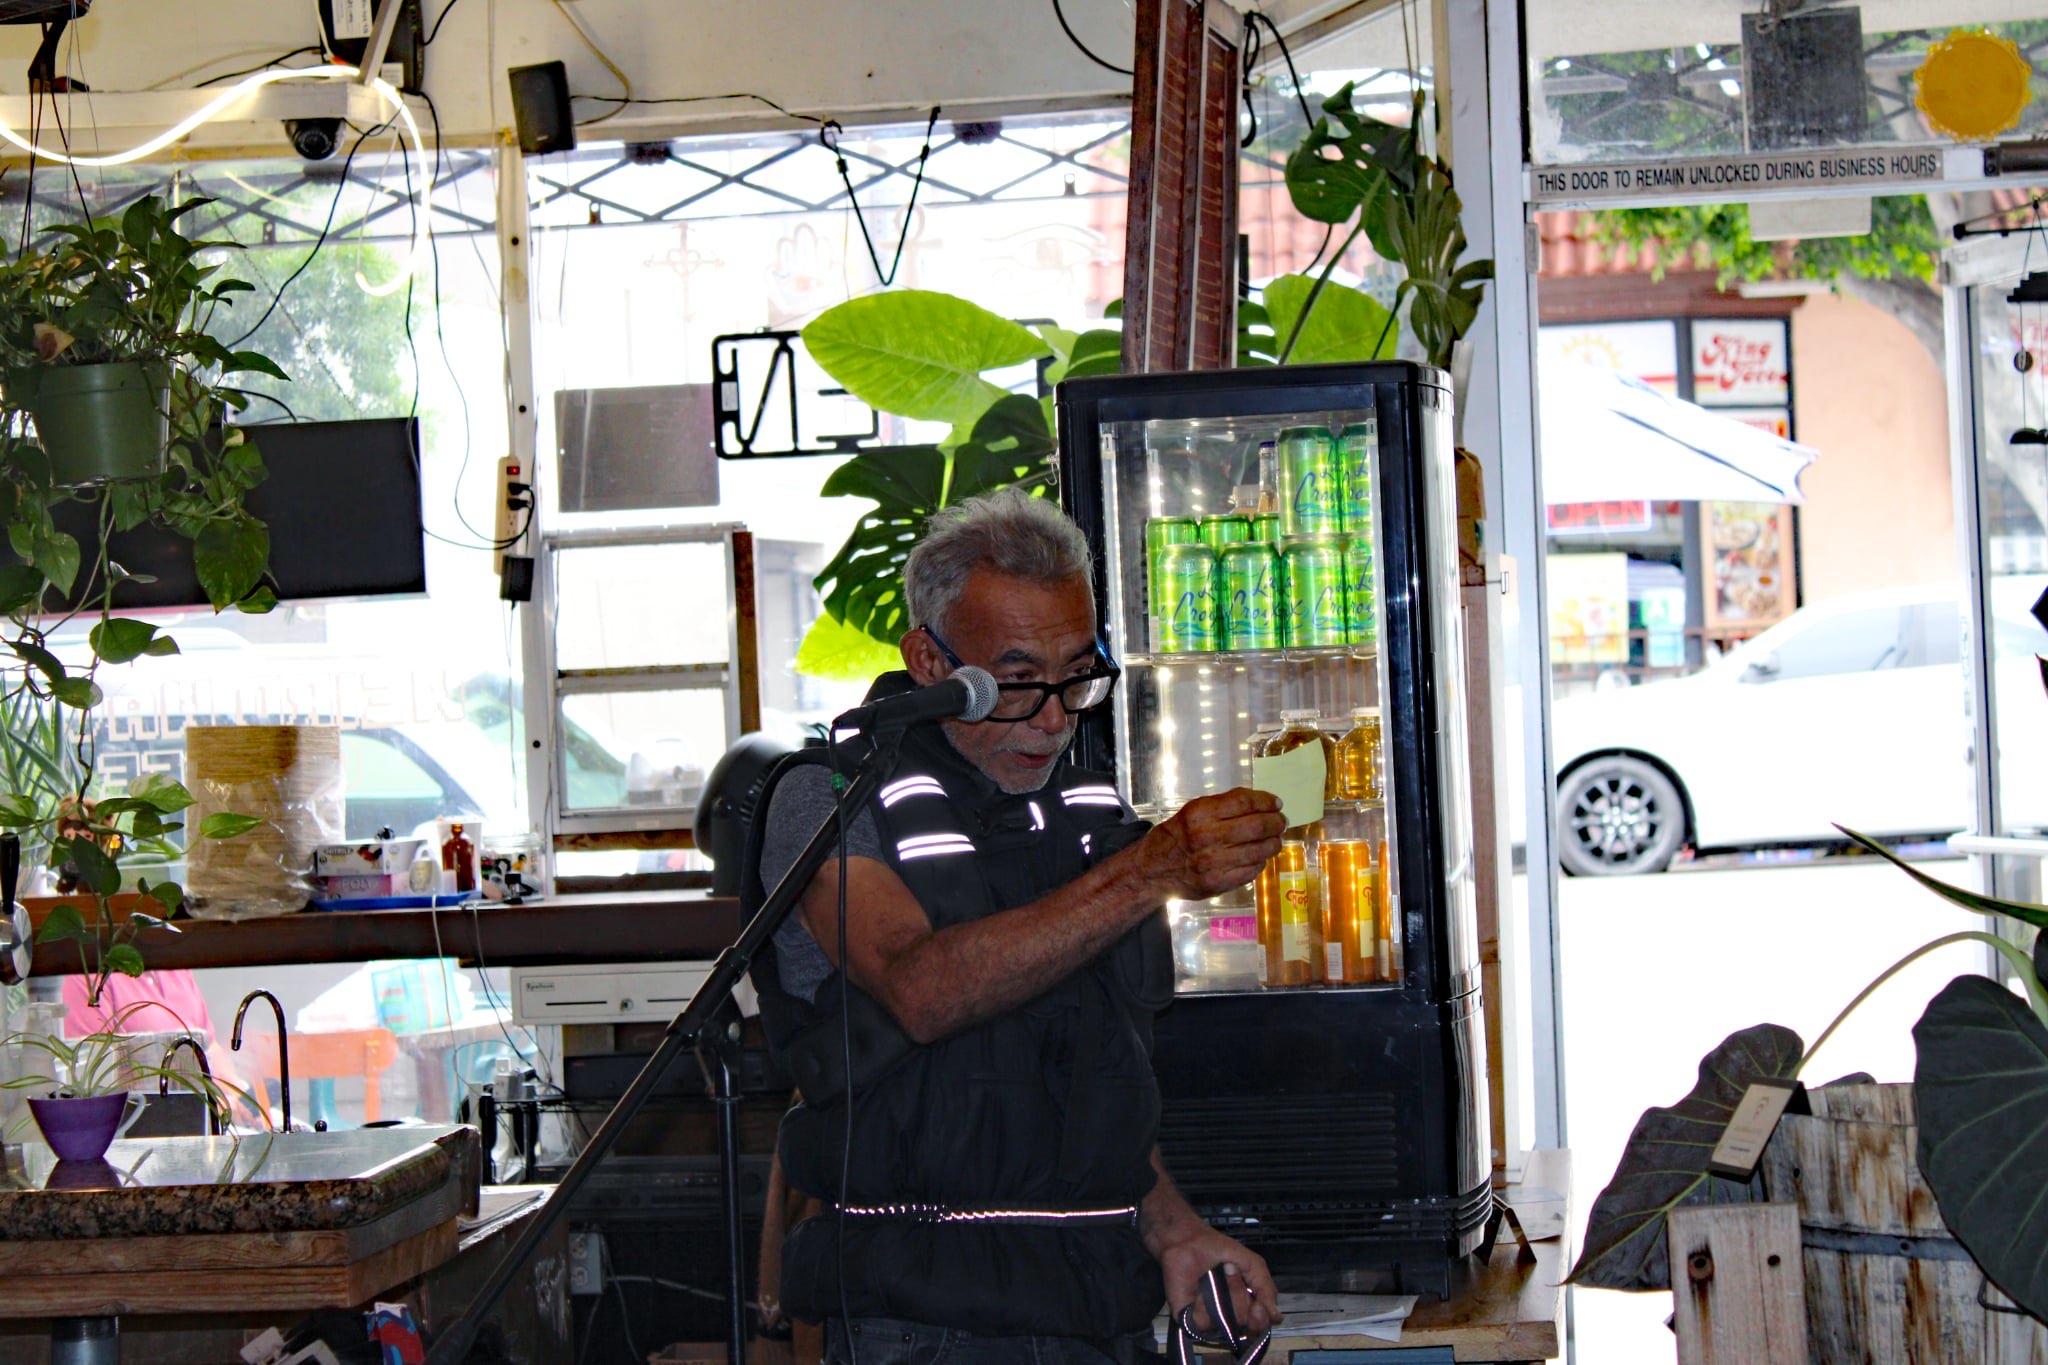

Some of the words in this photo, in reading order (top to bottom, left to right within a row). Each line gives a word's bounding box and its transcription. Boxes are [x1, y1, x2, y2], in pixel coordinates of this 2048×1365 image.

[1538, 172, 1566, 192] THIS
[1572, 171, 1609, 190] DOOR
[1615, 169, 1631, 189] TO
[1636, 167, 1685, 188] REMAIN
[1690, 163, 1760, 185] UNLOCKED
[1765, 160, 1815, 181] DURING
[1820, 156, 1885, 178] BUSINESS
[1891, 154, 1937, 174] HOURS
[1700, 335, 1772, 367] King
